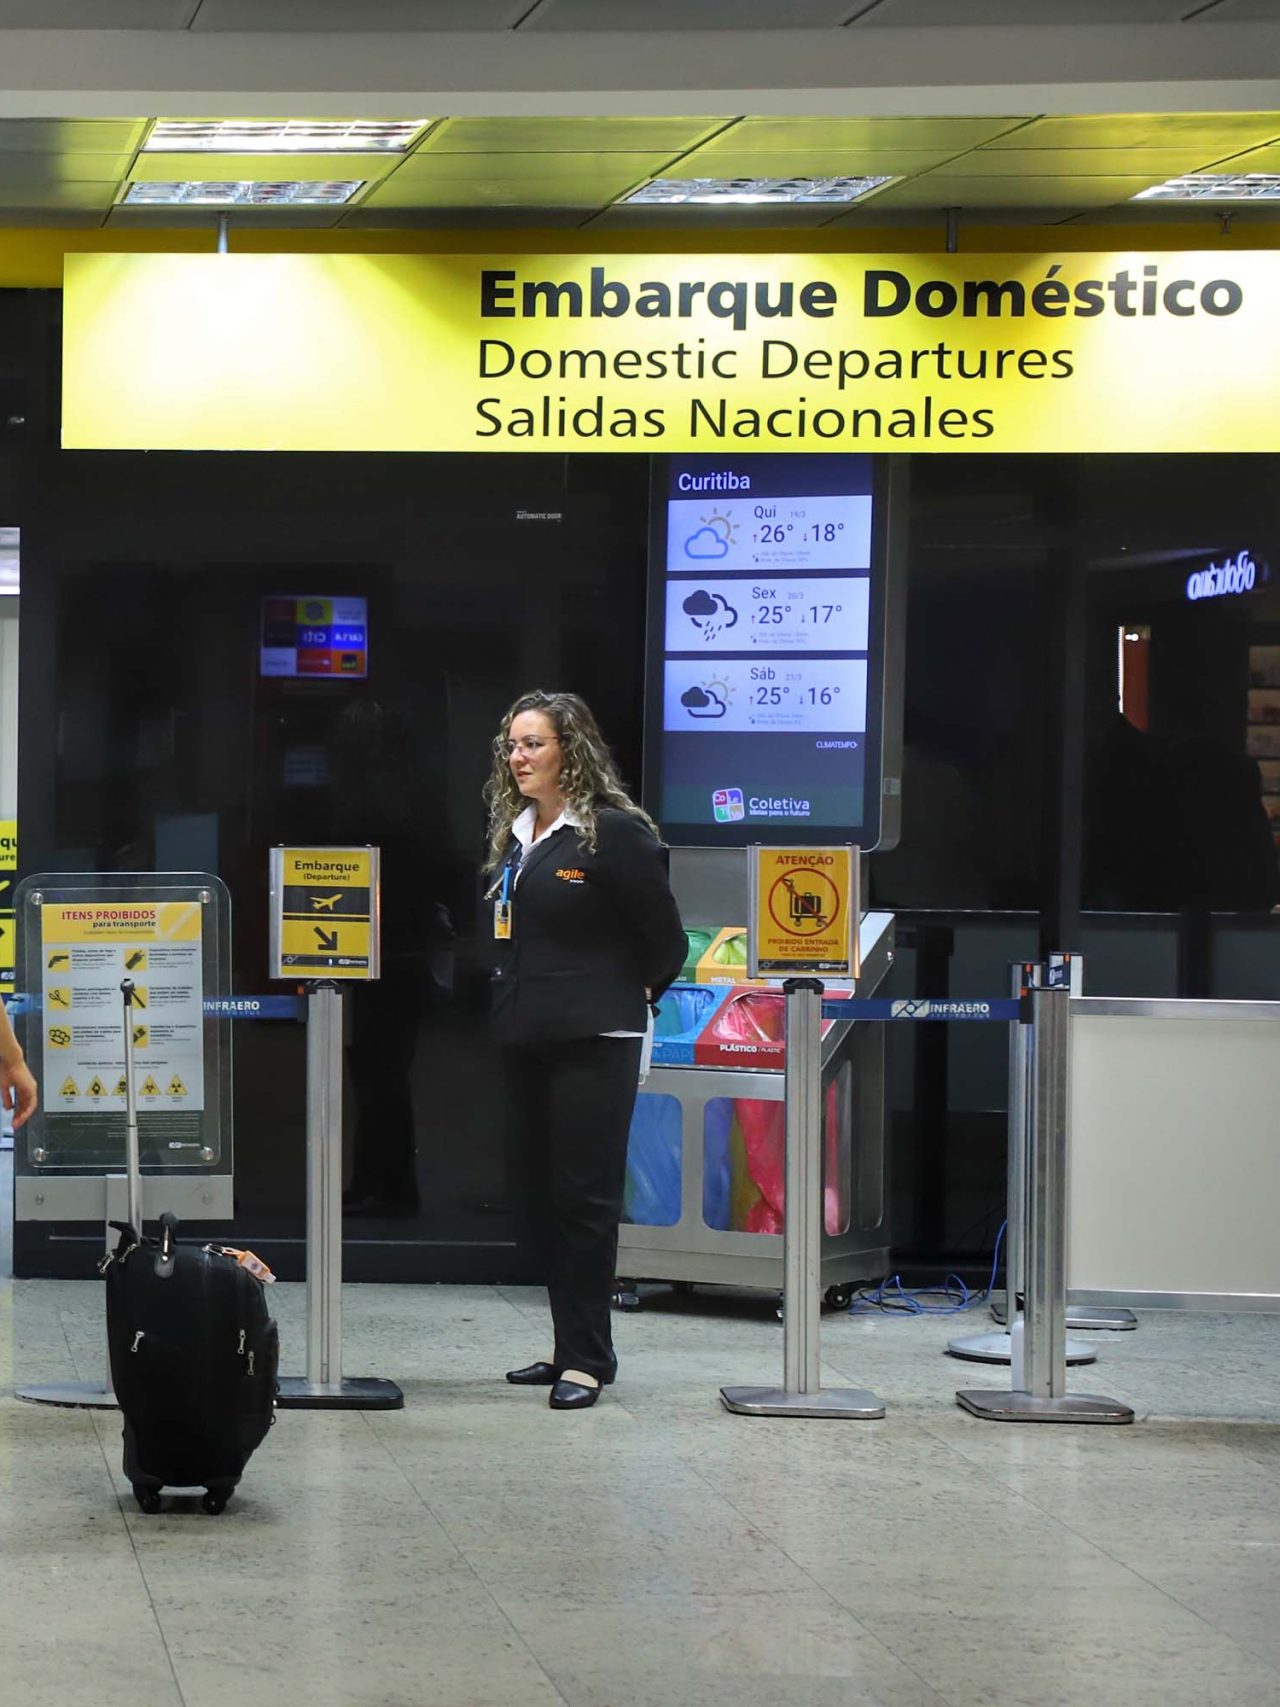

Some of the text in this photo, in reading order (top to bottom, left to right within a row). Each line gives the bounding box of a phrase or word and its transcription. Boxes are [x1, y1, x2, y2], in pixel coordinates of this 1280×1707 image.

[480, 264, 1244, 331] Embarque Doméstico
[478, 337, 1075, 390] Domestic Departures
[475, 395, 995, 438] Salidas Nacionales
[677, 471, 751, 492] Curitiba
[753, 505, 777, 520] Qui
[760, 522, 845, 543] 26° 18°
[751, 586, 777, 600] Sex
[758, 604, 843, 624] 25° 17°
[750, 667, 776, 681] Sáb
[756, 685, 841, 705] 25° 16°
[749, 797, 810, 810] Coletiva
[294, 860, 360, 873] Embarque
[775, 853, 834, 867] ATENÇÃO
[303, 873, 351, 881] (Departure)
[555, 868, 585, 881] agile
[61, 910, 156, 920] ITENS PROIBIDOS
[113, 920, 157, 928] transporte
[203, 1001, 260, 1011] INFRAERO
[930, 1003, 990, 1013] INFRAERO
[719, 1043, 758, 1054] PLÁSTICO
